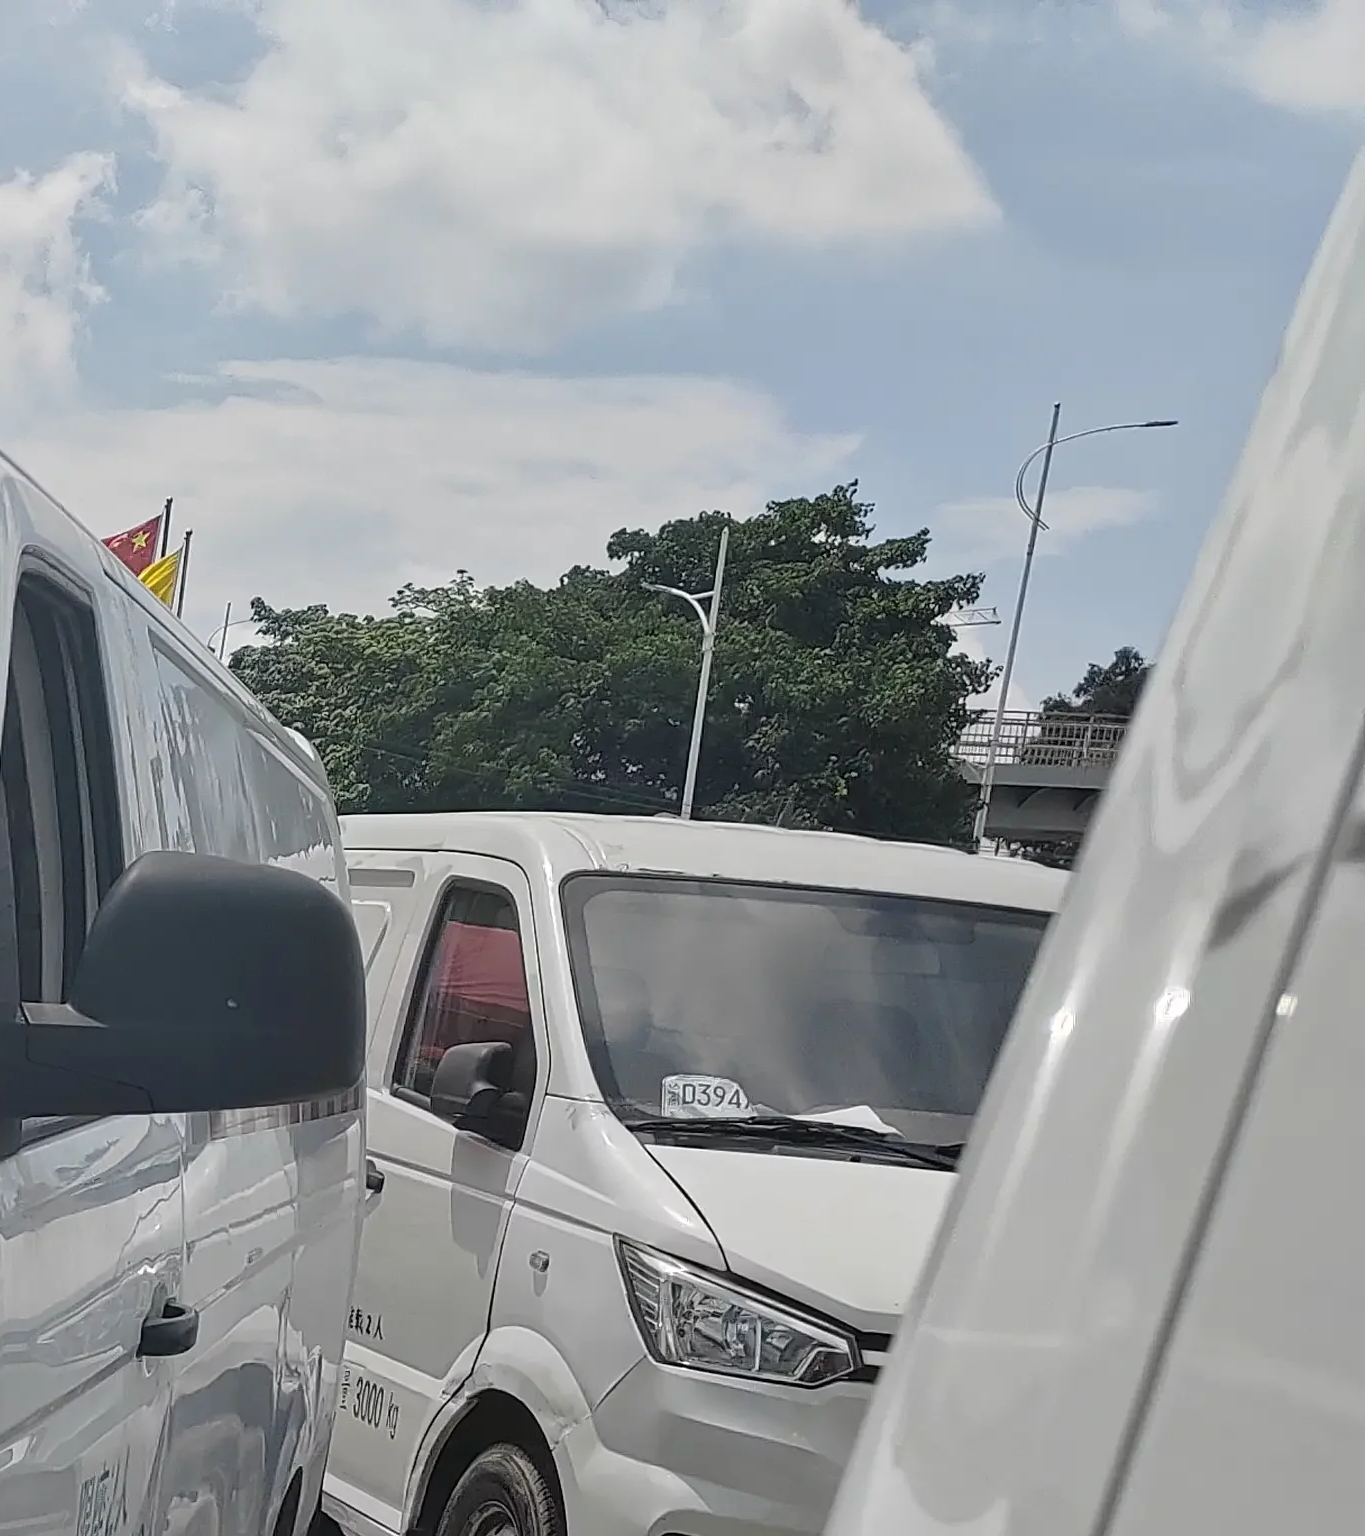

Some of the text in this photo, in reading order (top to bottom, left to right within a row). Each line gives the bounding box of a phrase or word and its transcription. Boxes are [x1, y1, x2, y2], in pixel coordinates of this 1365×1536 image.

[682, 1083, 750, 1110] D394
[353, 1376, 385, 1429] 3000
[386, 1391, 400, 1440] kg
